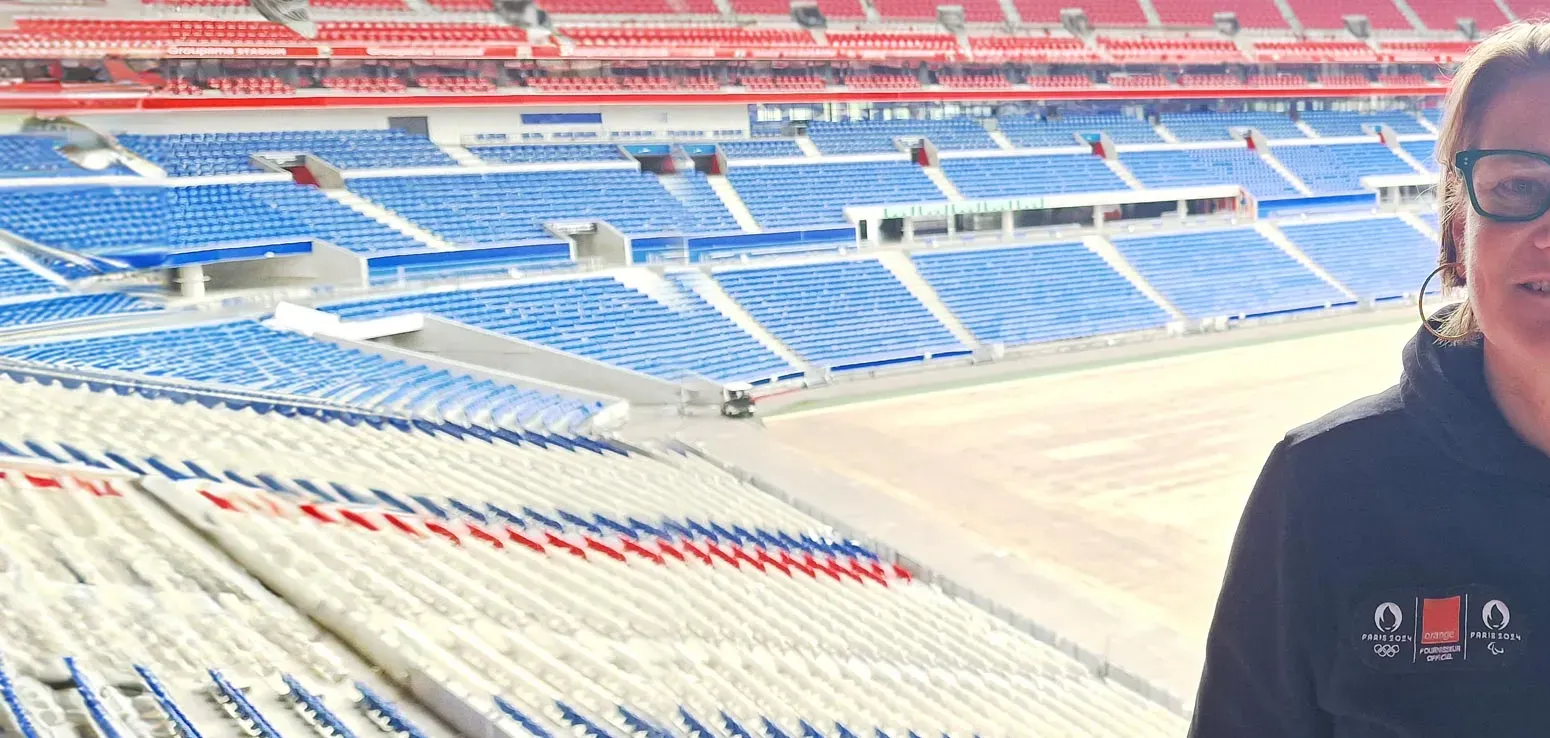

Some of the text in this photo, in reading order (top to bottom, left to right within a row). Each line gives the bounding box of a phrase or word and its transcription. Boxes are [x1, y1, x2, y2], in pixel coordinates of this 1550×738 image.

[1389, 634, 1412, 642] 2024
[1424, 631, 1455, 641] orange
[1470, 631, 1521, 641] PARIS 2024
